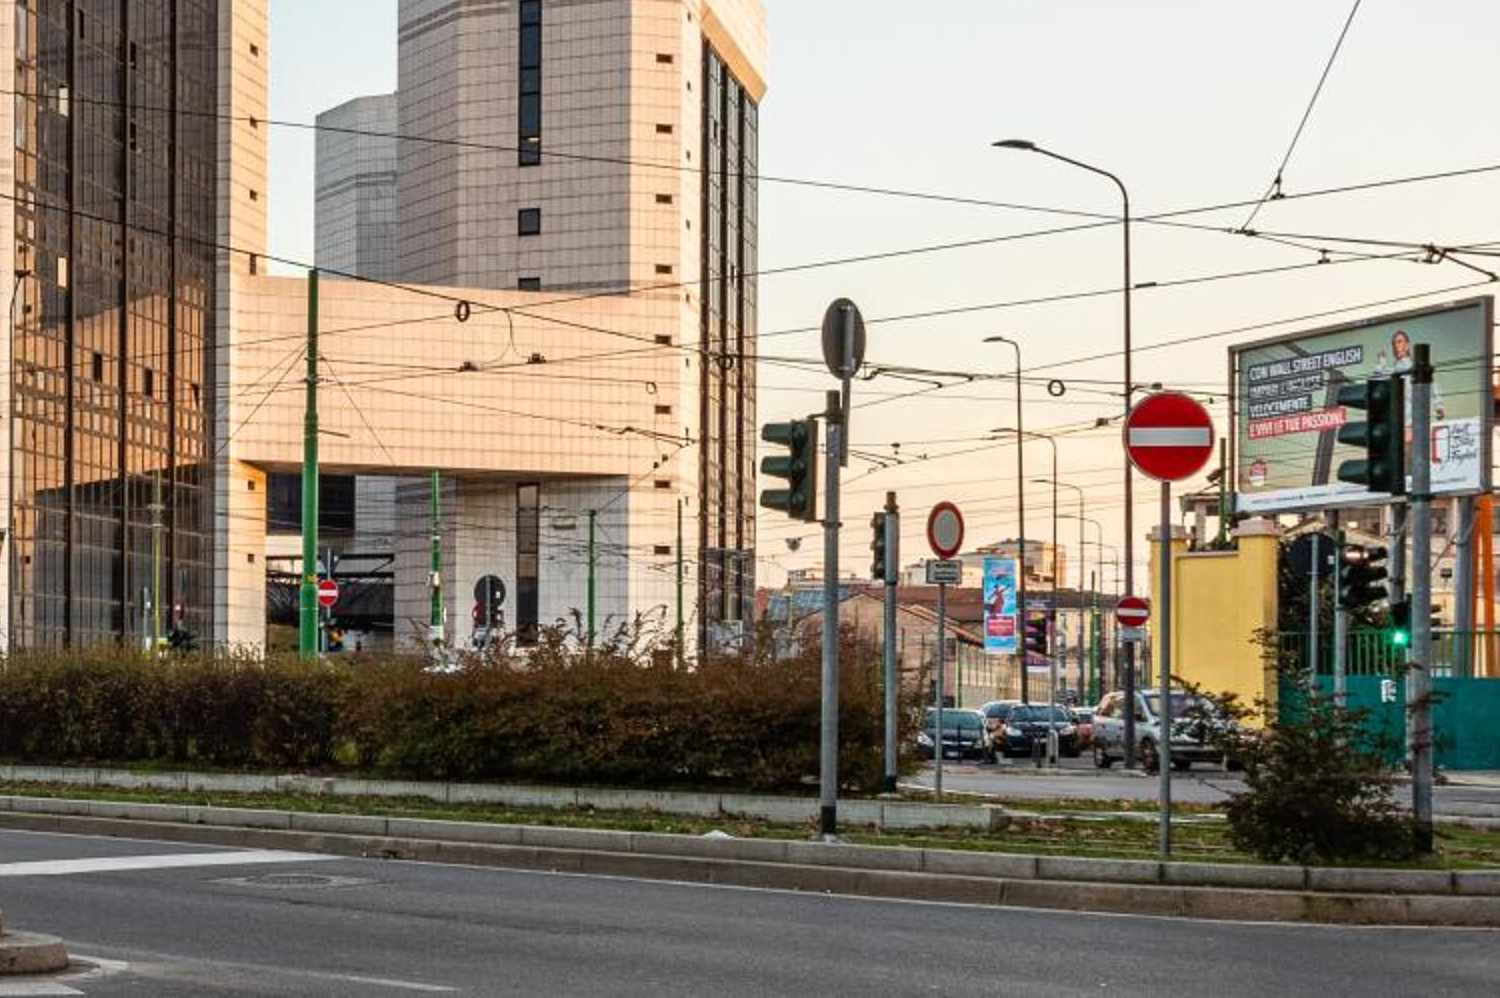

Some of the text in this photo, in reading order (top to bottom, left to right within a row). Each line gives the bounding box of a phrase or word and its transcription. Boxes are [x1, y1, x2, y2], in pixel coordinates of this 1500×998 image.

[1269, 362, 1290, 376] WALL
[1292, 355, 1321, 372] STREET
[1323, 347, 1361, 367] ENGLISH
